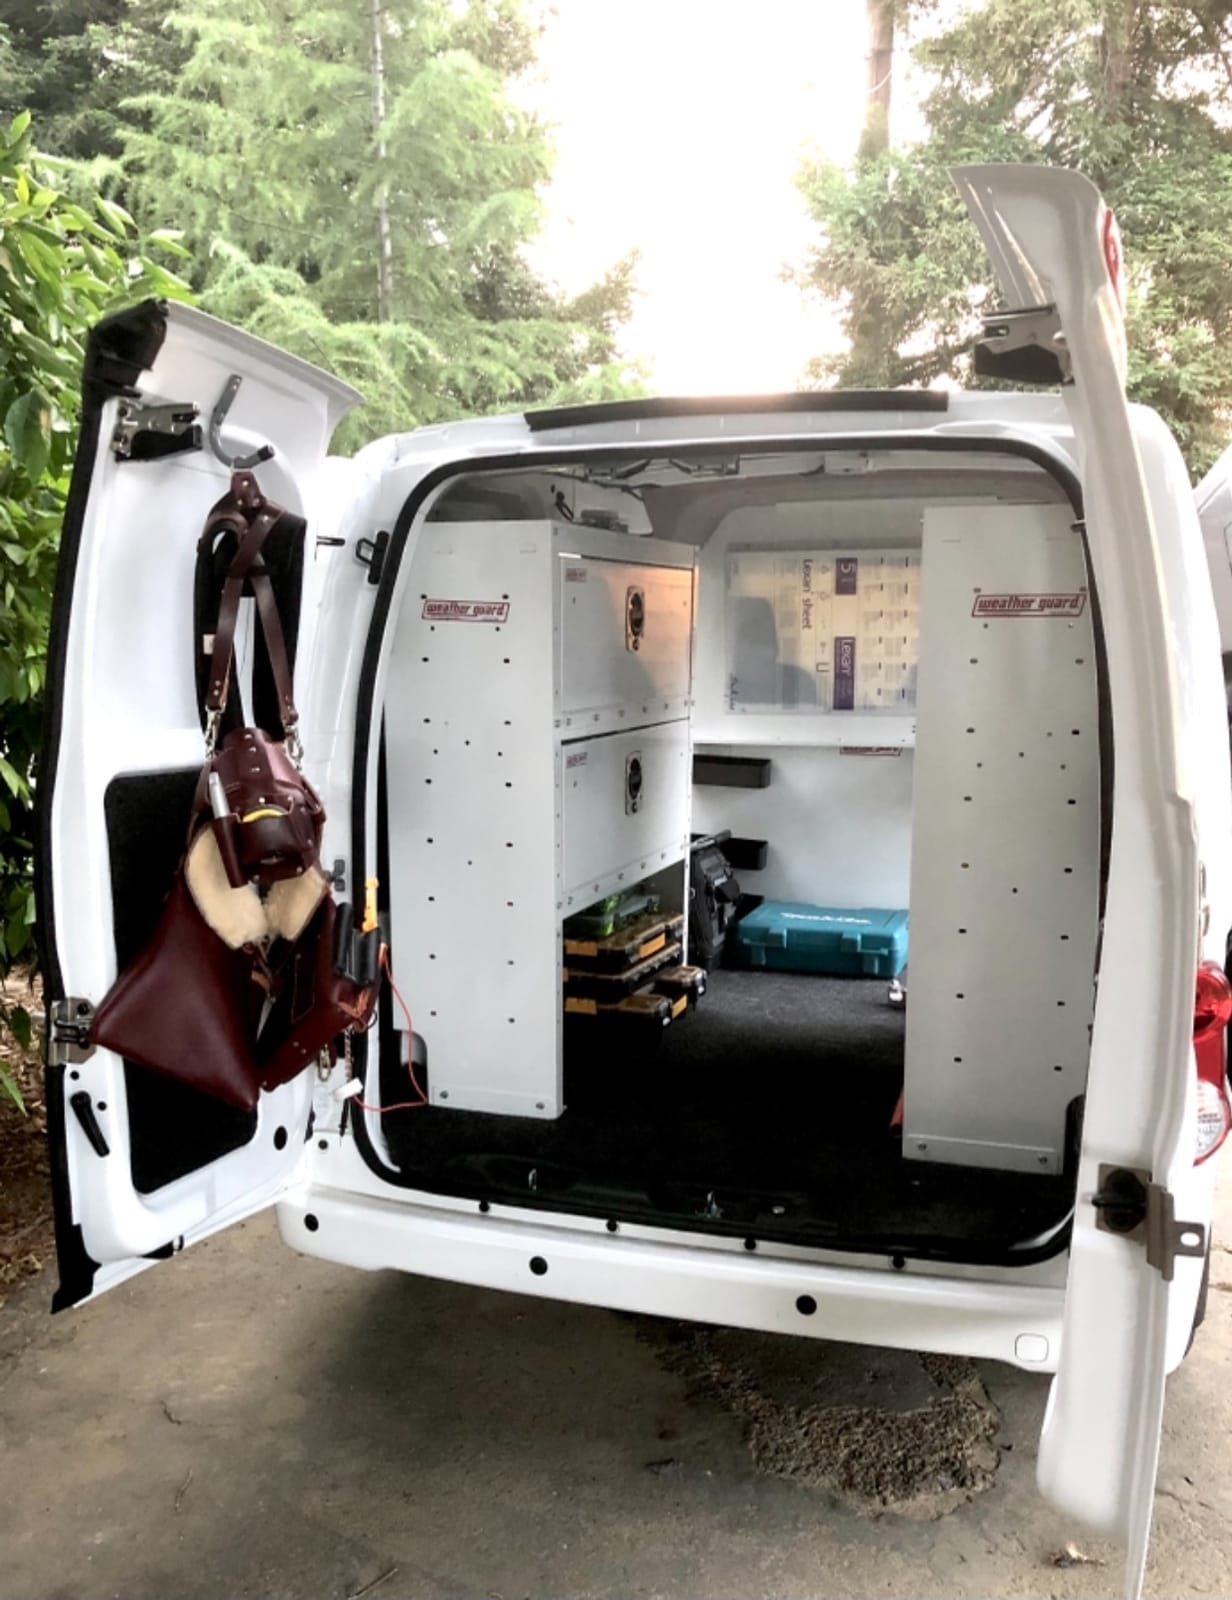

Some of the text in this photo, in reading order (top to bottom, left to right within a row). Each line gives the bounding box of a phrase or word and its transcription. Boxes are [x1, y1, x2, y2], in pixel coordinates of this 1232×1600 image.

[426, 601, 505, 616] weather guard
[979, 595, 1080, 611] weather guard
[802, 598, 813, 630] sheet
